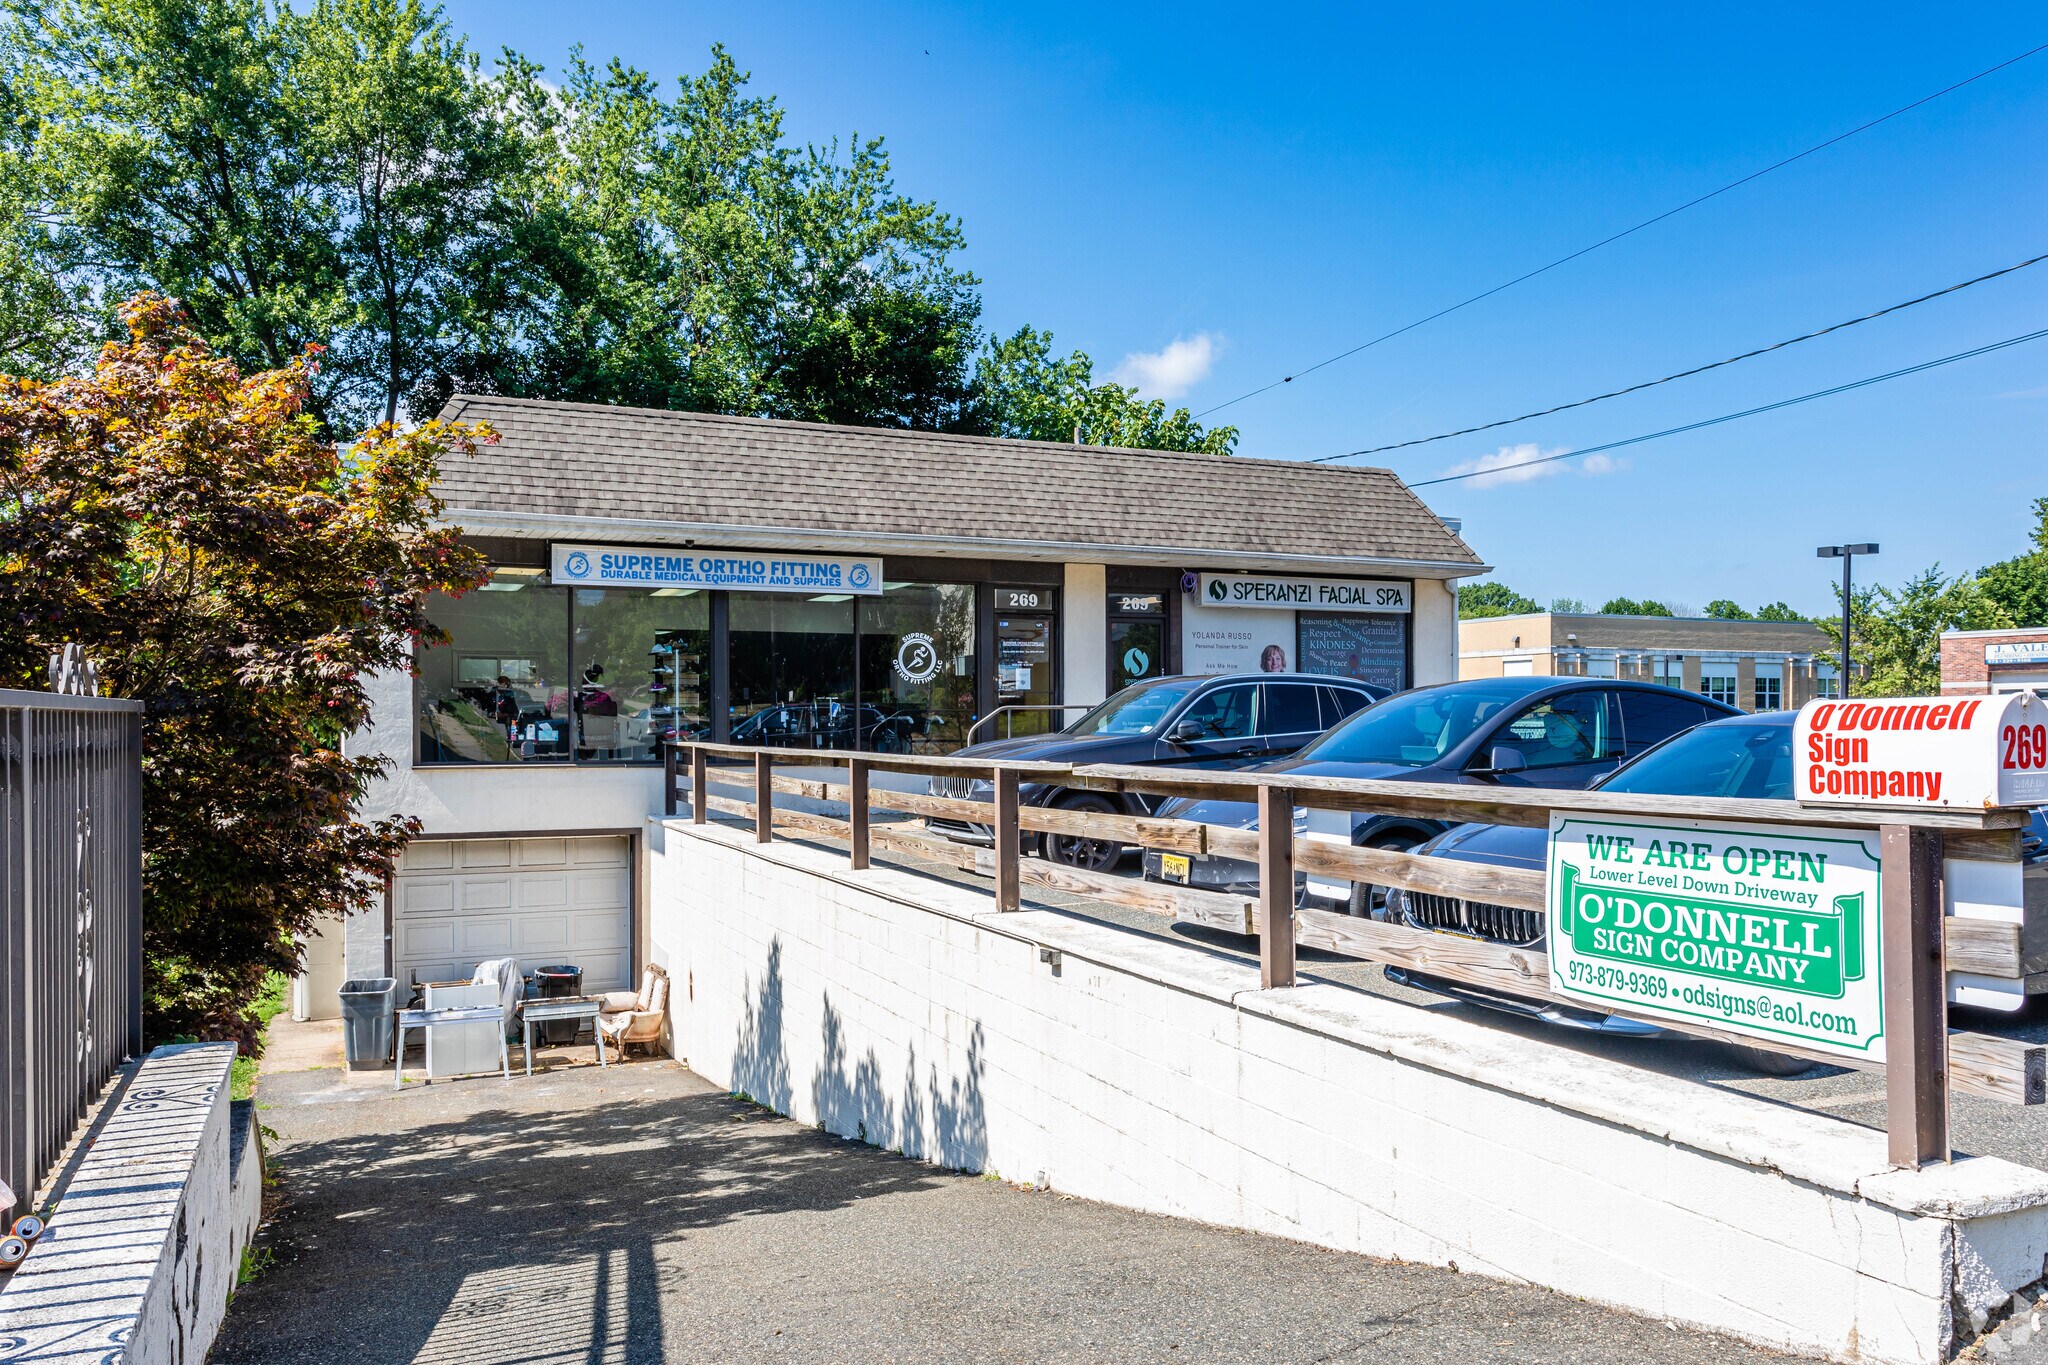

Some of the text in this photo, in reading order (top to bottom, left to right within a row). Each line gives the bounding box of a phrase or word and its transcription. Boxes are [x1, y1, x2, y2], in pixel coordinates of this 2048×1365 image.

[601, 554, 841, 578] SUPREME ORTHO FITTING
[601, 570, 841, 586] DURABLE MEDICAL EQUIPMENT AND SUPPLIES
[1010, 593, 1038, 607] 269
[1234, 582, 1403, 606] SPERANZI FACIAL SPA
[1300, 618, 1333, 627] Reasoning
[1342, 618, 1369, 626] Happiness
[902, 632, 934, 643] SUPREME
[1192, 632, 1252, 640] YOLANDA RUSSO
[1310, 629, 1341, 640] Respect
[1362, 626, 1398, 635] Gratitude
[1310, 640, 1356, 650] KINDNESS
[1308, 650, 1328, 666] Sharing
[1322, 650, 1346, 658] Courage
[1361, 656, 1403, 666] Mindfulness
[893, 659, 943, 684] ORTHO FITTING LLC
[1304, 666, 1339, 675] LOVE IS
[1360, 667, 1389, 675] Sincerity
[1370, 676, 1395, 687] Caring
[1810, 700, 1982, 731] O'Donnell
[1808, 732, 1868, 766] Sign
[2003, 724, 2046, 769] 269
[1809, 764, 1942, 801] Company
[1586, 834, 1828, 883] WE ARE OPEN
[1590, 865, 1818, 908] Lower Level Down Driveway
[1578, 893, 1832, 958] O'DONNELL
[1593, 927, 1810, 984] SIGN COMPANY
[1569, 960, 1858, 1036] 973-879-9369 odsigns@aol.com
